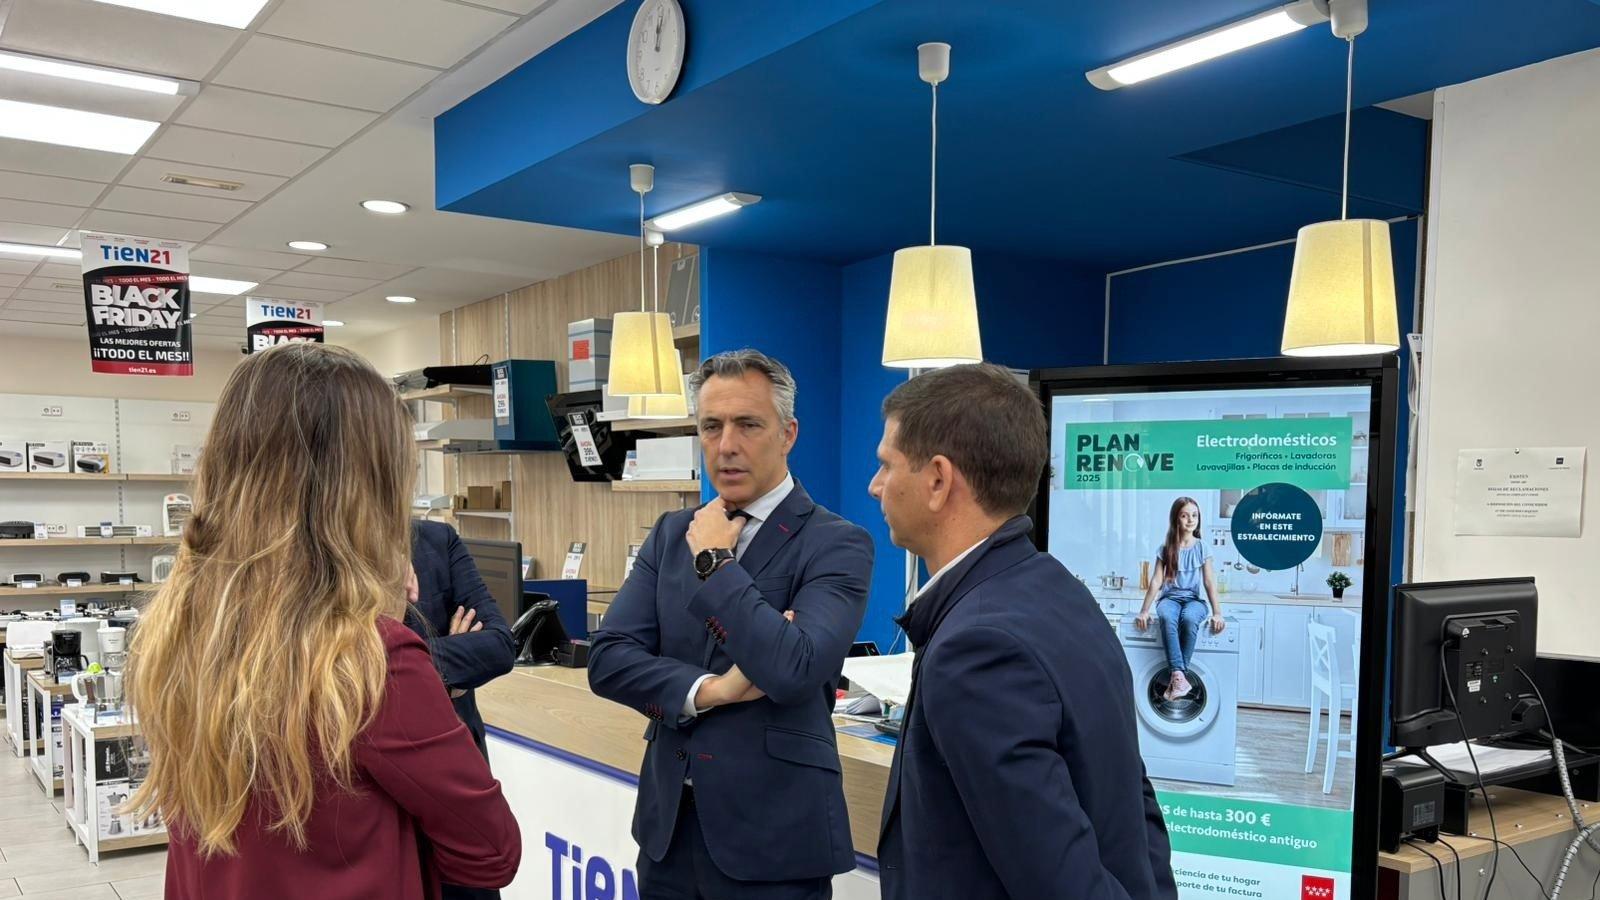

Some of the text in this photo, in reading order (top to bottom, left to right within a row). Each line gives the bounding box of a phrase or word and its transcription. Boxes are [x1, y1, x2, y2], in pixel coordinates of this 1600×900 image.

[91, 284, 180, 310] BLACK
[92, 306, 181, 328] FRIDAY
[138, 350, 154, 360] EL
[156, 350, 190, 361] MES!!
[1077, 434, 1139, 452] PLAN
[1196, 432, 1337, 448] Electrodomésticos
[1076, 453, 1174, 472] RENOVE
[1236, 452, 1282, 461] Frigoríficos
[1196, 463, 1245, 472] Lavavajillas
[1252, 512, 1302, 520] INFÓRMATE
[1173, 807, 1188, 816] de
[1190, 808, 1222, 821] hasta
[1225, 809, 1257, 824] 300
[1260, 813, 1271, 827] €
[1269, 835, 1318, 849] antiguo
[1174, 868, 1260, 887] ciencia de tu hogar
[1176, 881, 1262, 898] porte de tu factura
